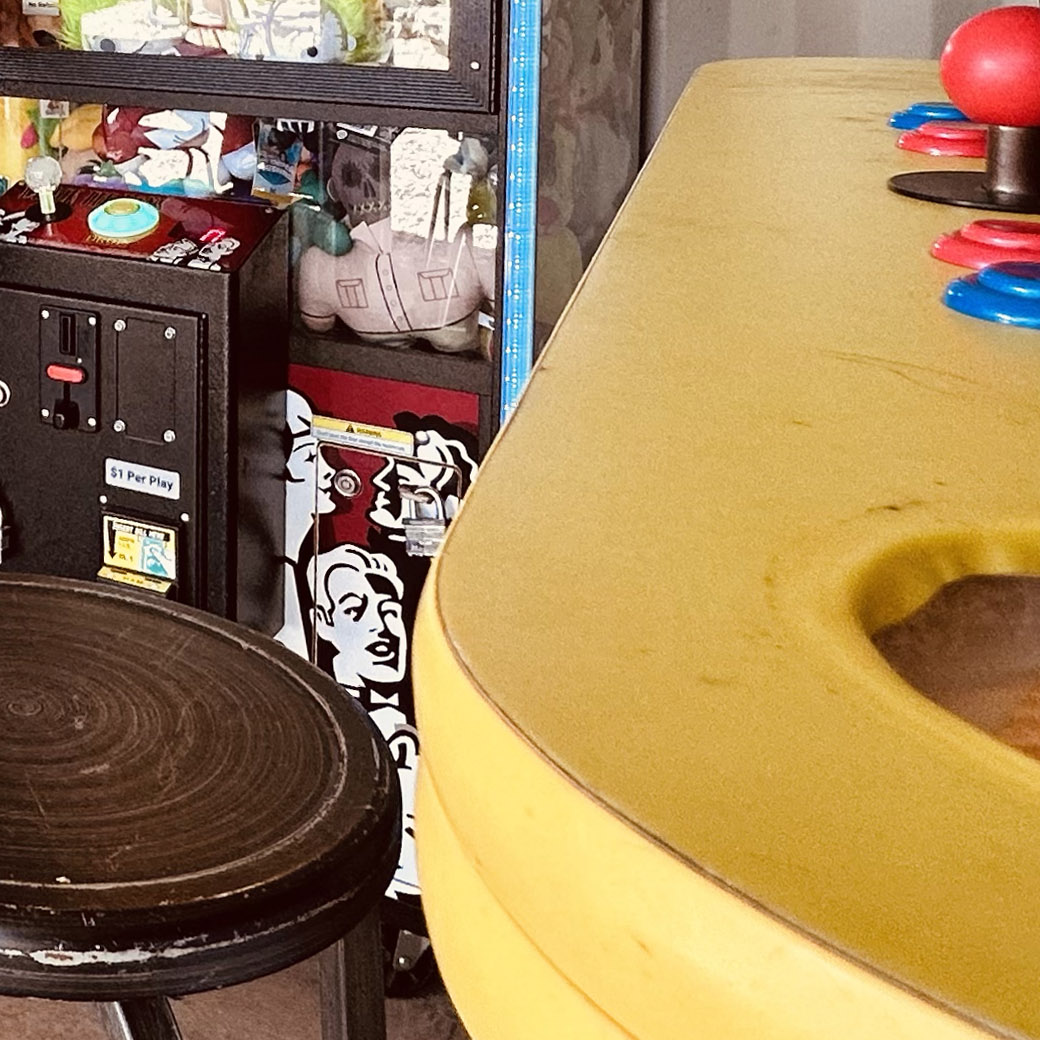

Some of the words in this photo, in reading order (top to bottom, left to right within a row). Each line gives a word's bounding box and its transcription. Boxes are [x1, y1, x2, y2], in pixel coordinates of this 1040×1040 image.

[111, 465, 124, 479] $1
[127, 470, 147, 484] Per
[149, 475, 174, 492] Play
